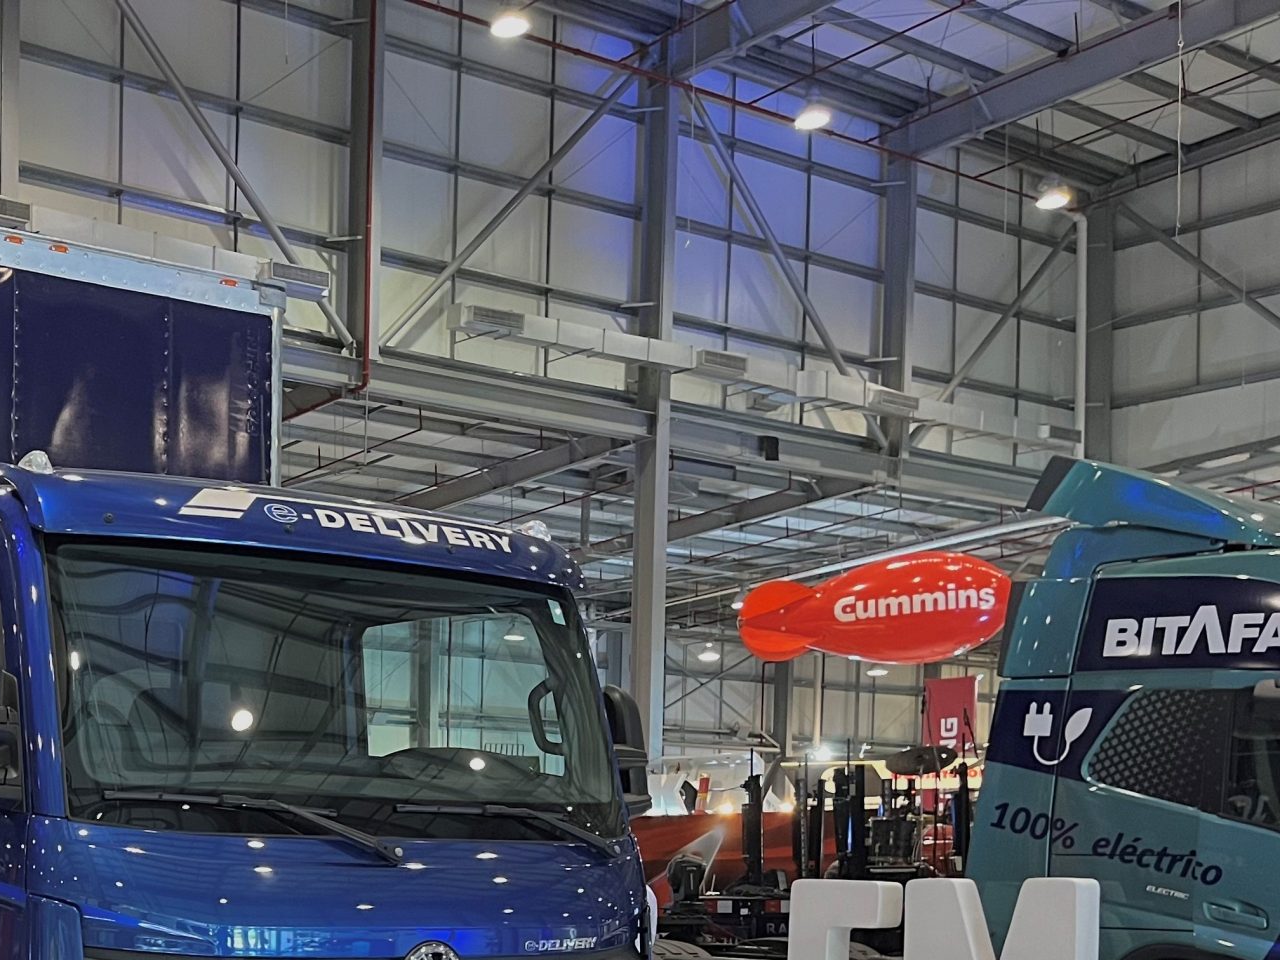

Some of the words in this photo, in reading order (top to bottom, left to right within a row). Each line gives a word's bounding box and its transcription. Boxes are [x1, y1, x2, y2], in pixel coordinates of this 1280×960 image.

[263, 502, 513, 554] e-DELIVERY
[834, 584, 995, 622] Cummins
[989, 802, 1080, 850] 100%
[1091, 832, 1223, 886] eléctrico
